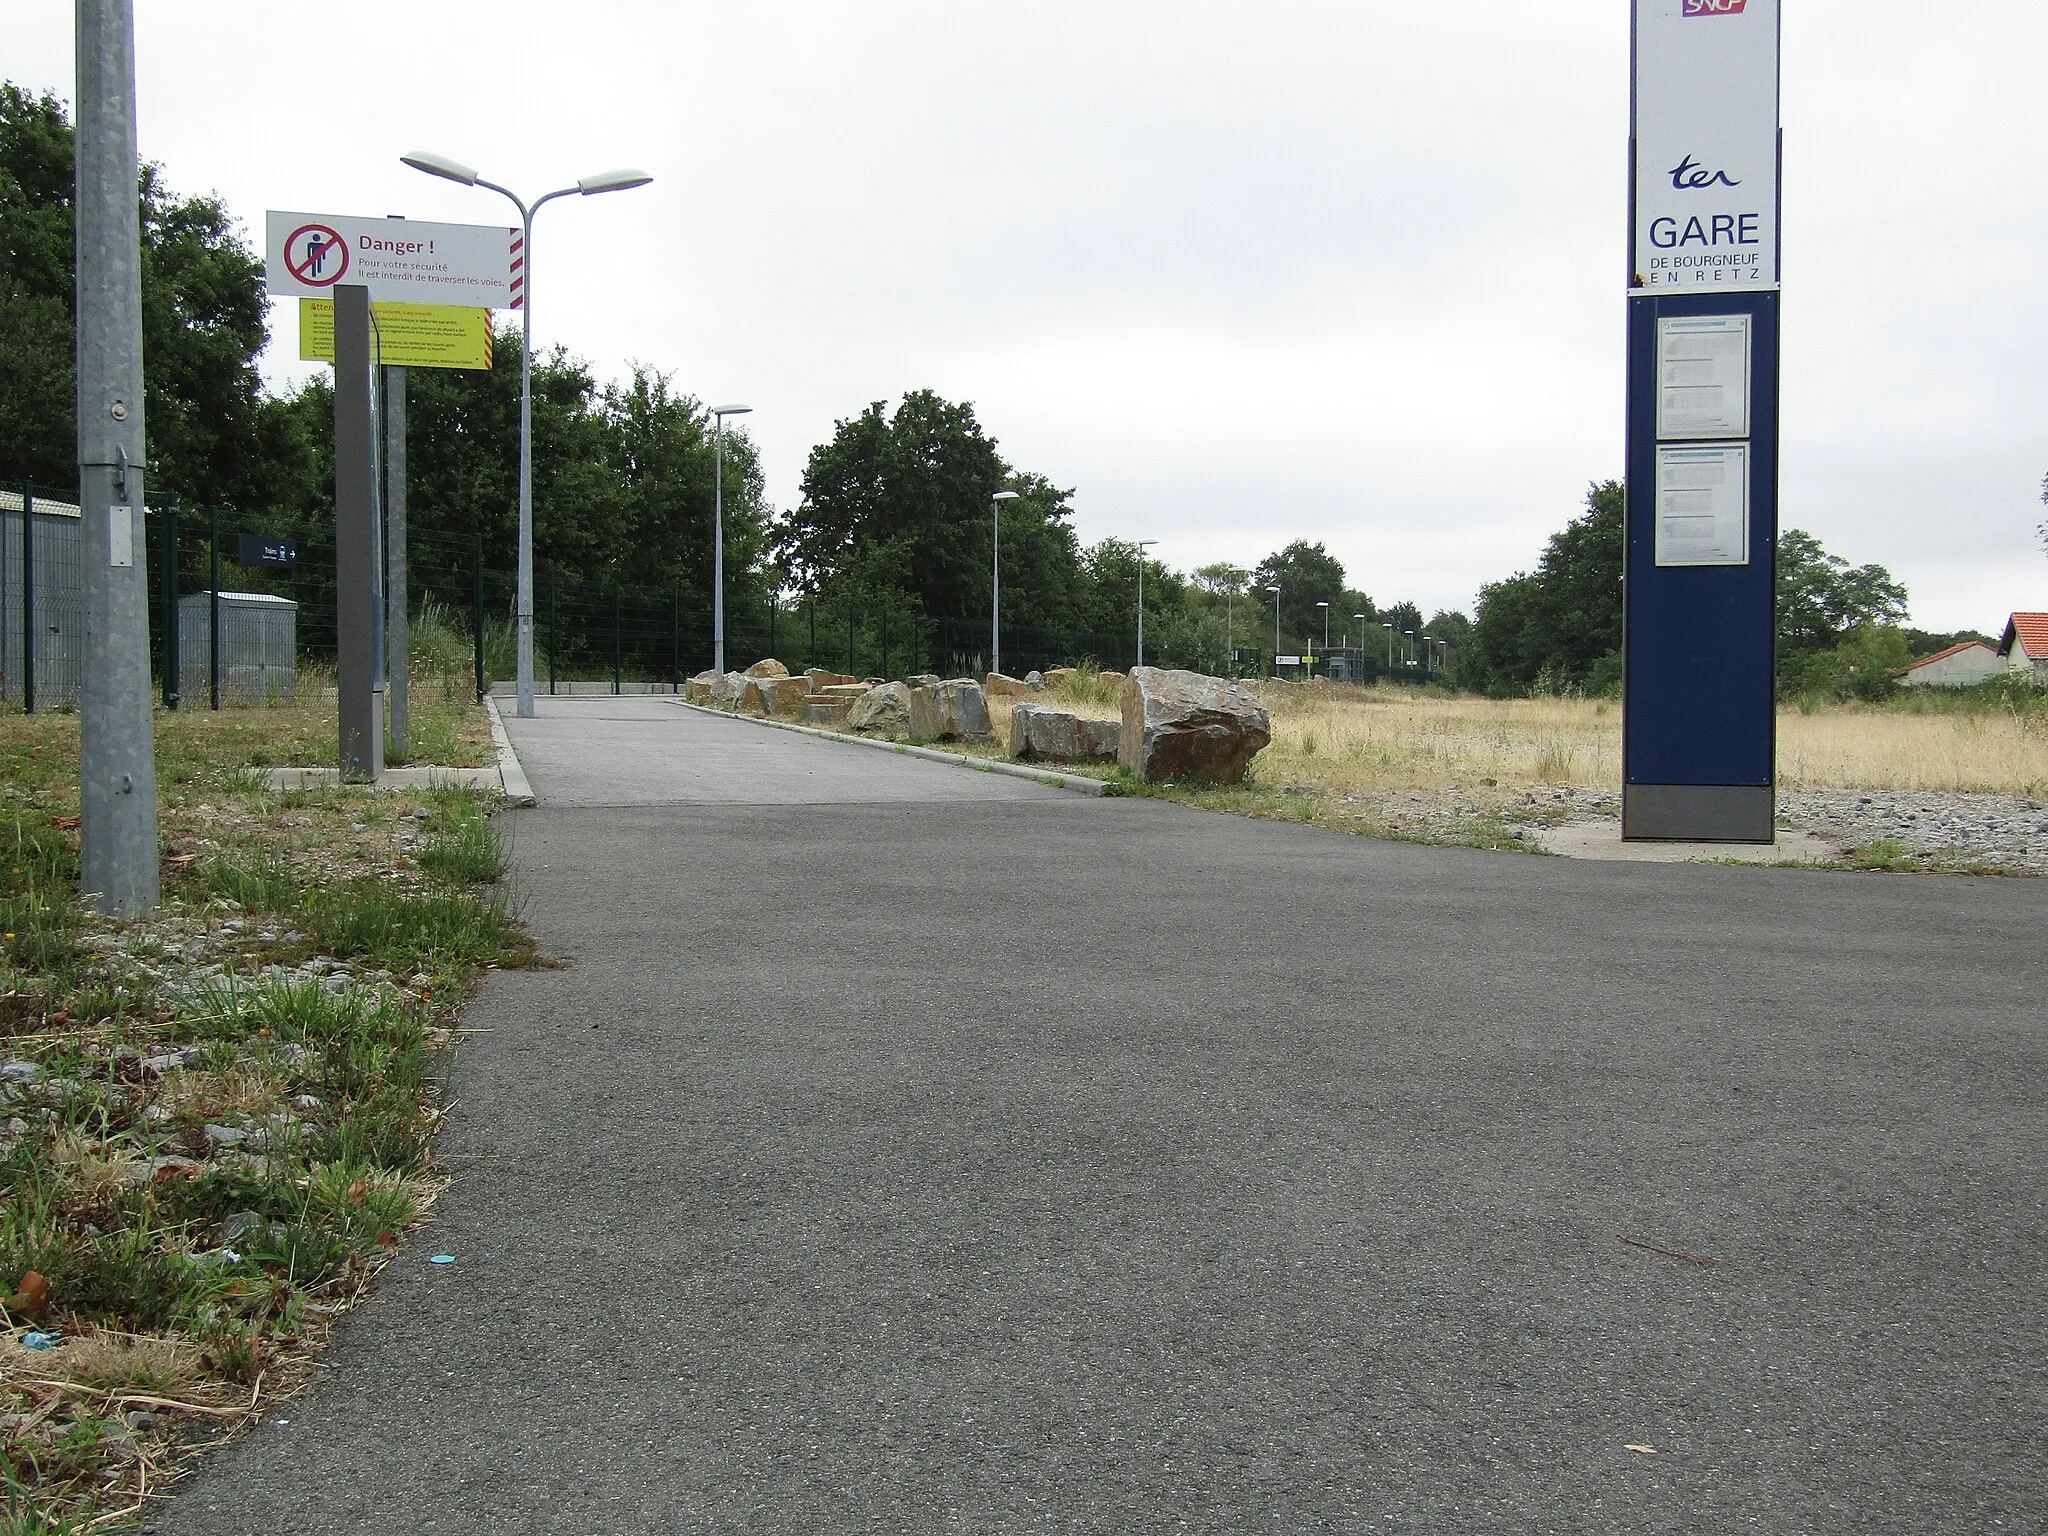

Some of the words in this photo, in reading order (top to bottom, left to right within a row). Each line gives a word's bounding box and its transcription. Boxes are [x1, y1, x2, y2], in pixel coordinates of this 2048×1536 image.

[1667, 153, 1742, 190] ter
[1649, 213, 1759, 249] GARE
[359, 235, 424, 256] Danger
[429, 240, 435, 254] !
[358, 258, 380, 268] Pour
[382, 261, 408, 269] votre
[410, 262, 448, 272] sécurité
[1650, 257, 1668, 269] DE
[1674, 253, 1759, 268] BOURGNEUF
[381, 271, 414, 281] interdit
[415, 274, 426, 282] de
[427, 276, 466, 284] traverser
[467, 277, 479, 285] les
[480, 278, 506, 287] voies.
[1650, 270, 1678, 284] EN
[1696, 268, 1759, 281] RETZ
[311, 302, 333, 311] Atten
